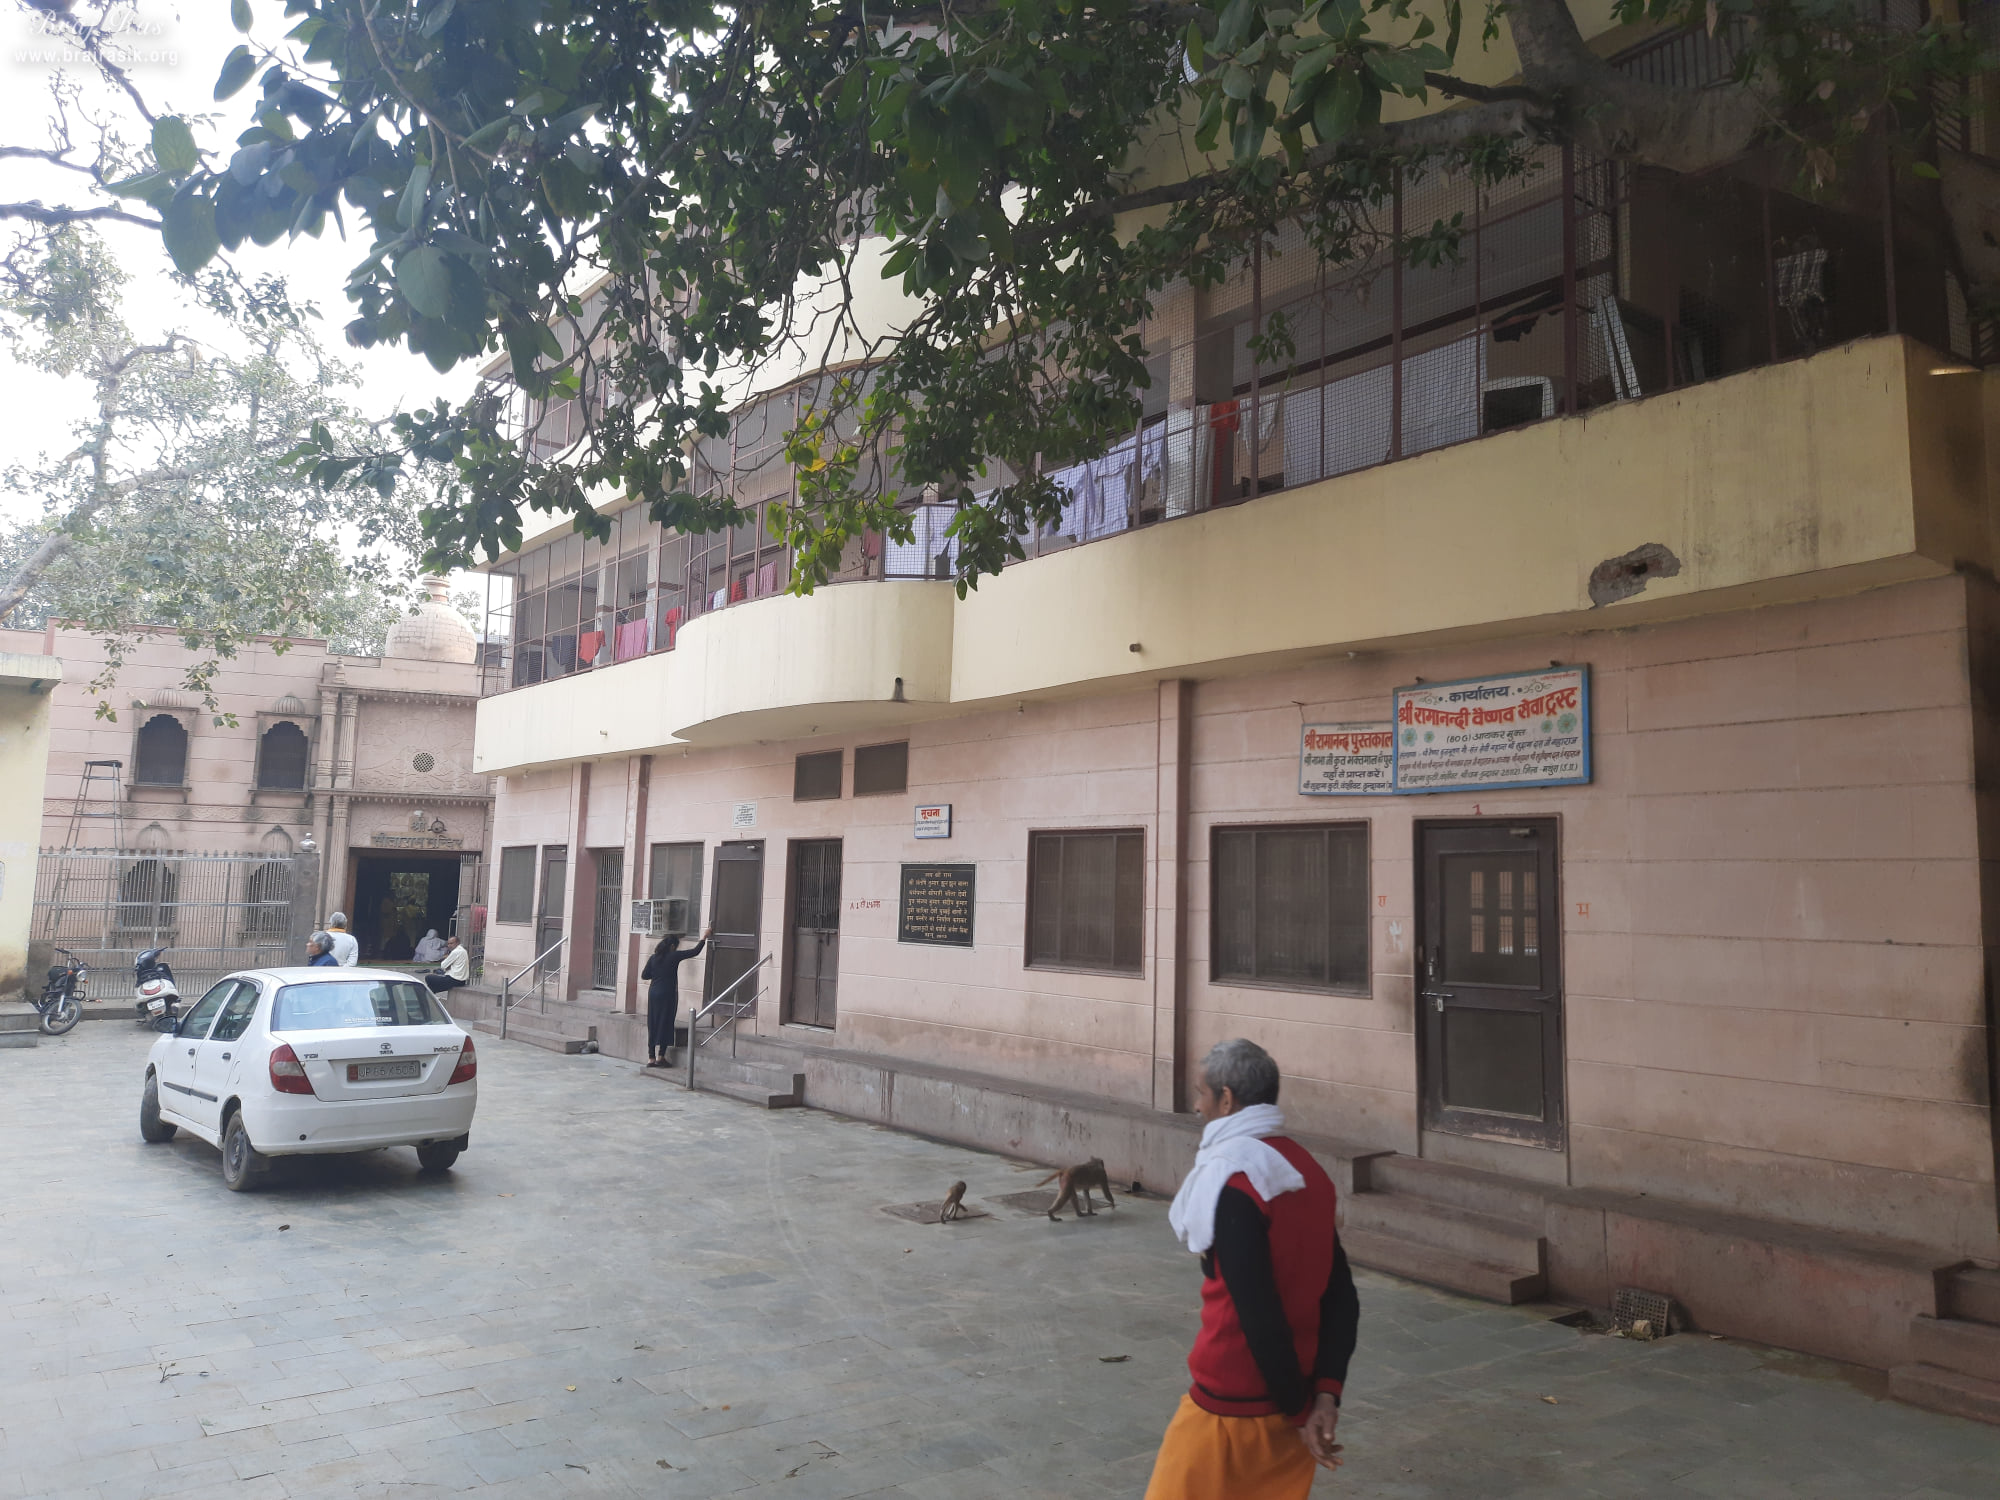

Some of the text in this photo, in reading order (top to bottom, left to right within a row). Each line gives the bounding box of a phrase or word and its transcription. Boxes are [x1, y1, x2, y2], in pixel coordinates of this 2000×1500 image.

[1449, 685, 1511, 703] कार्यालय
[1399, 687, 1578, 729] श्री रामानन्दी वैष्णव सेवा ट्रस्ट
[1305, 729, 1316, 750] श्री
[1316, 734, 1349, 752] रामानन्द
[1472, 731, 1505, 741] आयकर
[1506, 729, 1527, 742] मुक्त
[921, 809, 940, 819] सूचना
